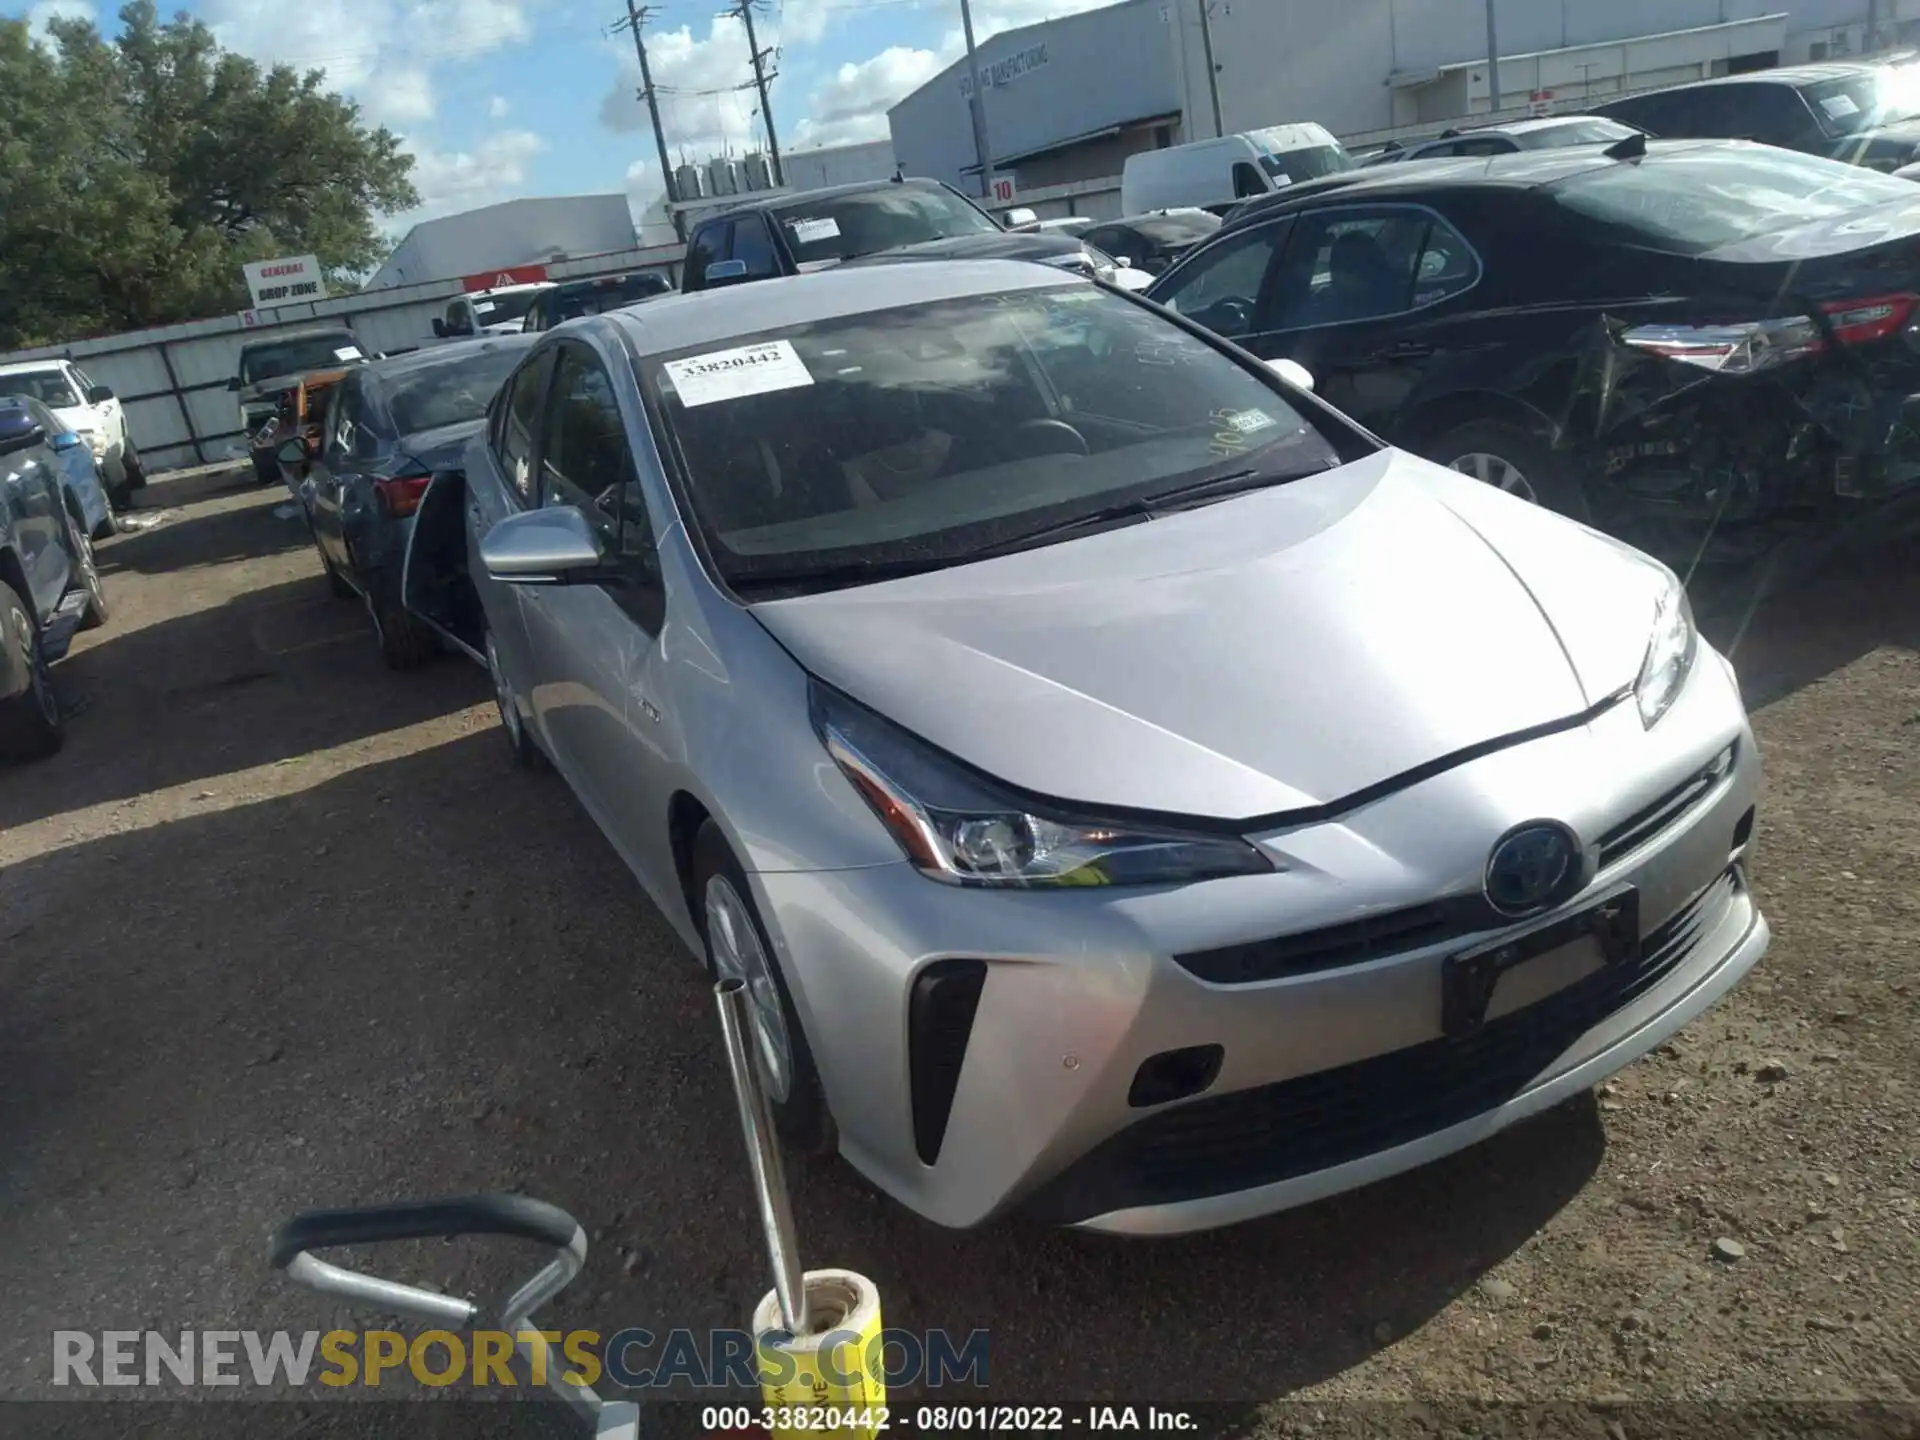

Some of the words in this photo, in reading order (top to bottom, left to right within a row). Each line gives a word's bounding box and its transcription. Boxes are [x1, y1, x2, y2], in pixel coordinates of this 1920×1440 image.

[994, 181, 1012, 201] 10
[259, 286, 289, 301] DROP
[291, 281, 318, 296] ZONE
[244, 312, 254, 326] 5
[682, 351, 782, 378] 33820442
